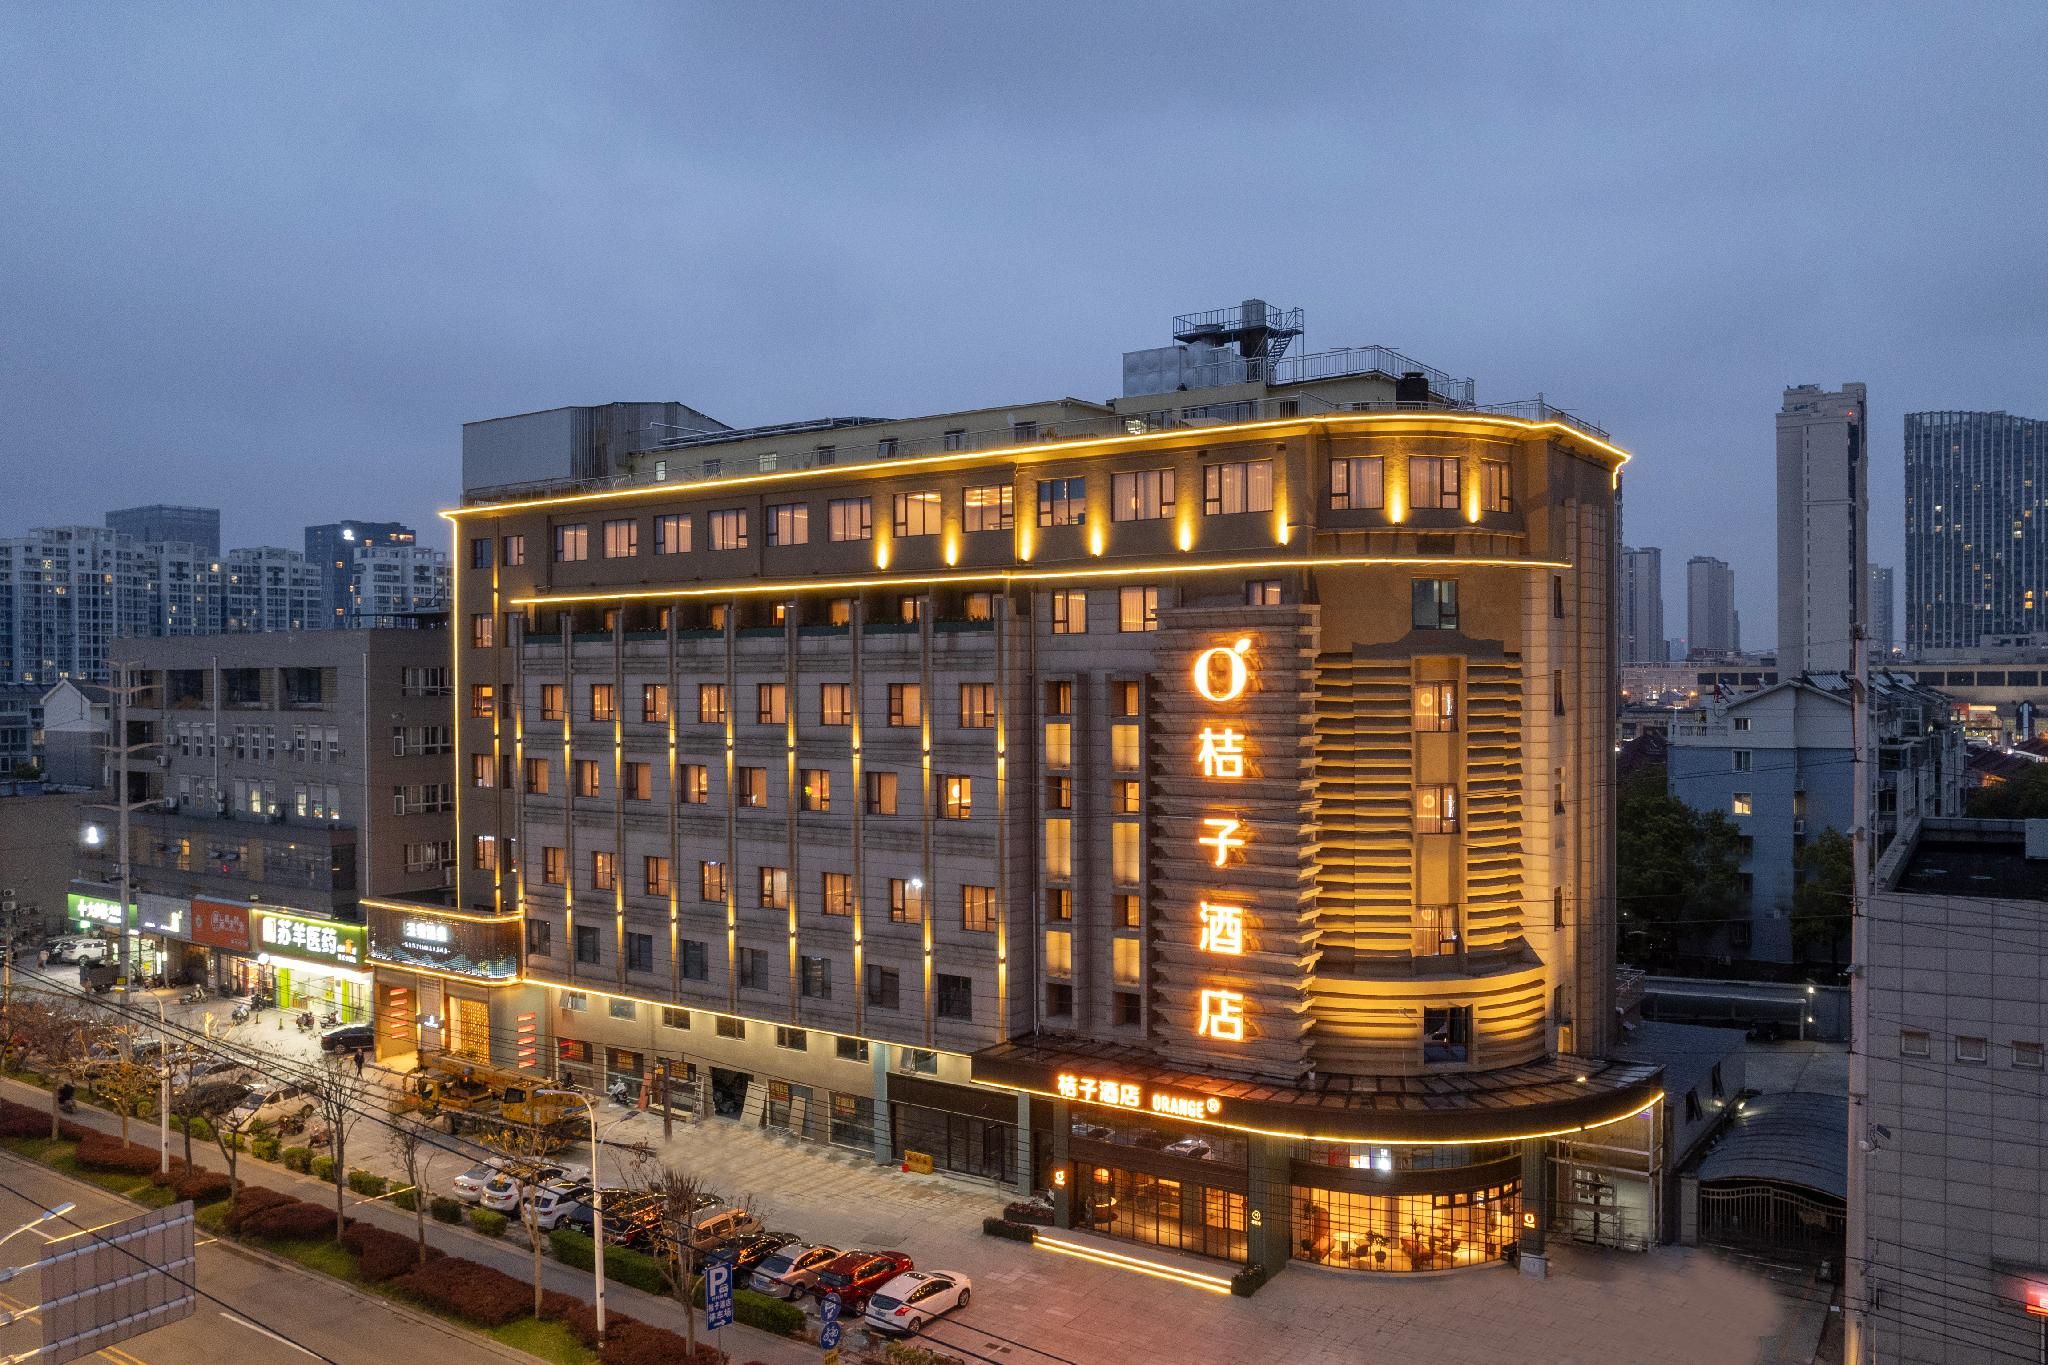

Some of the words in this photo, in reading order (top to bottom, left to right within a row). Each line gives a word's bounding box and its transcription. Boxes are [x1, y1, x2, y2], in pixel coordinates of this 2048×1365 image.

[1198, 727, 1246, 1041] 桔子酒店
[1057, 1074, 1140, 1107] 桔子酒店
[709, 1266, 728, 1297] P
